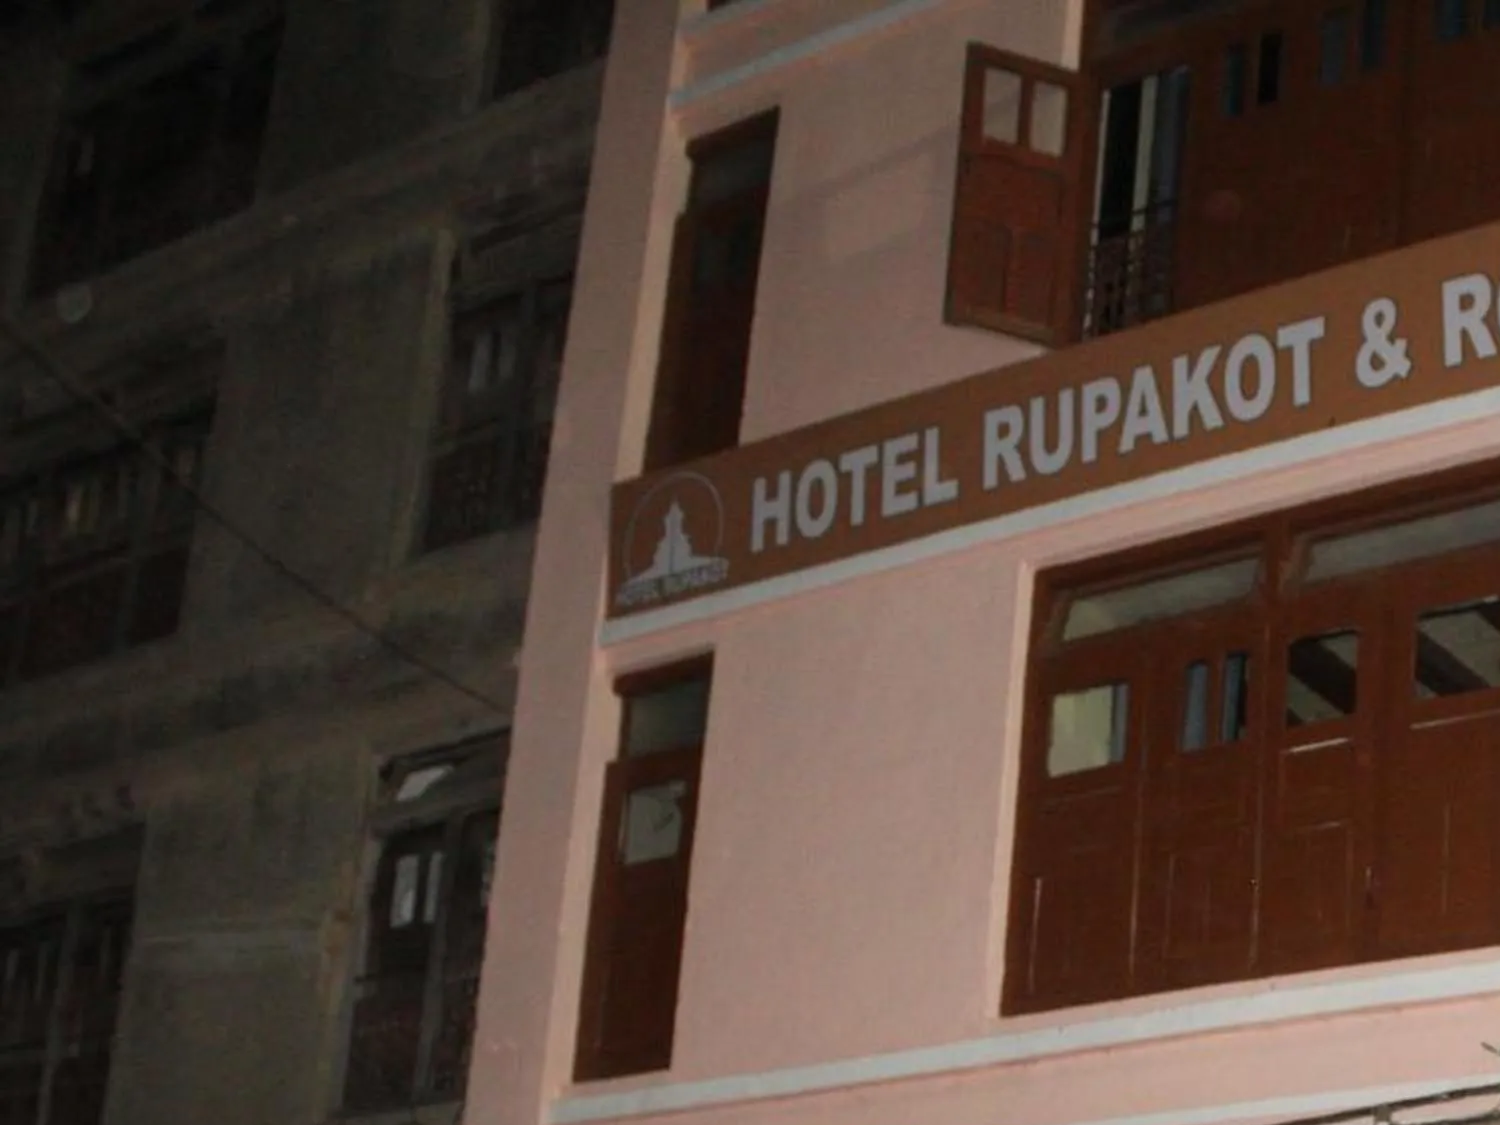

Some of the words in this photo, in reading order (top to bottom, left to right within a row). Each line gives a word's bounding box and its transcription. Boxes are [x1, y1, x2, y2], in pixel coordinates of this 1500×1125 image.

[751, 425, 958, 554] HOTEL
[982, 315, 1326, 491] RUPAKOT
[1355, 297, 1413, 389] &
